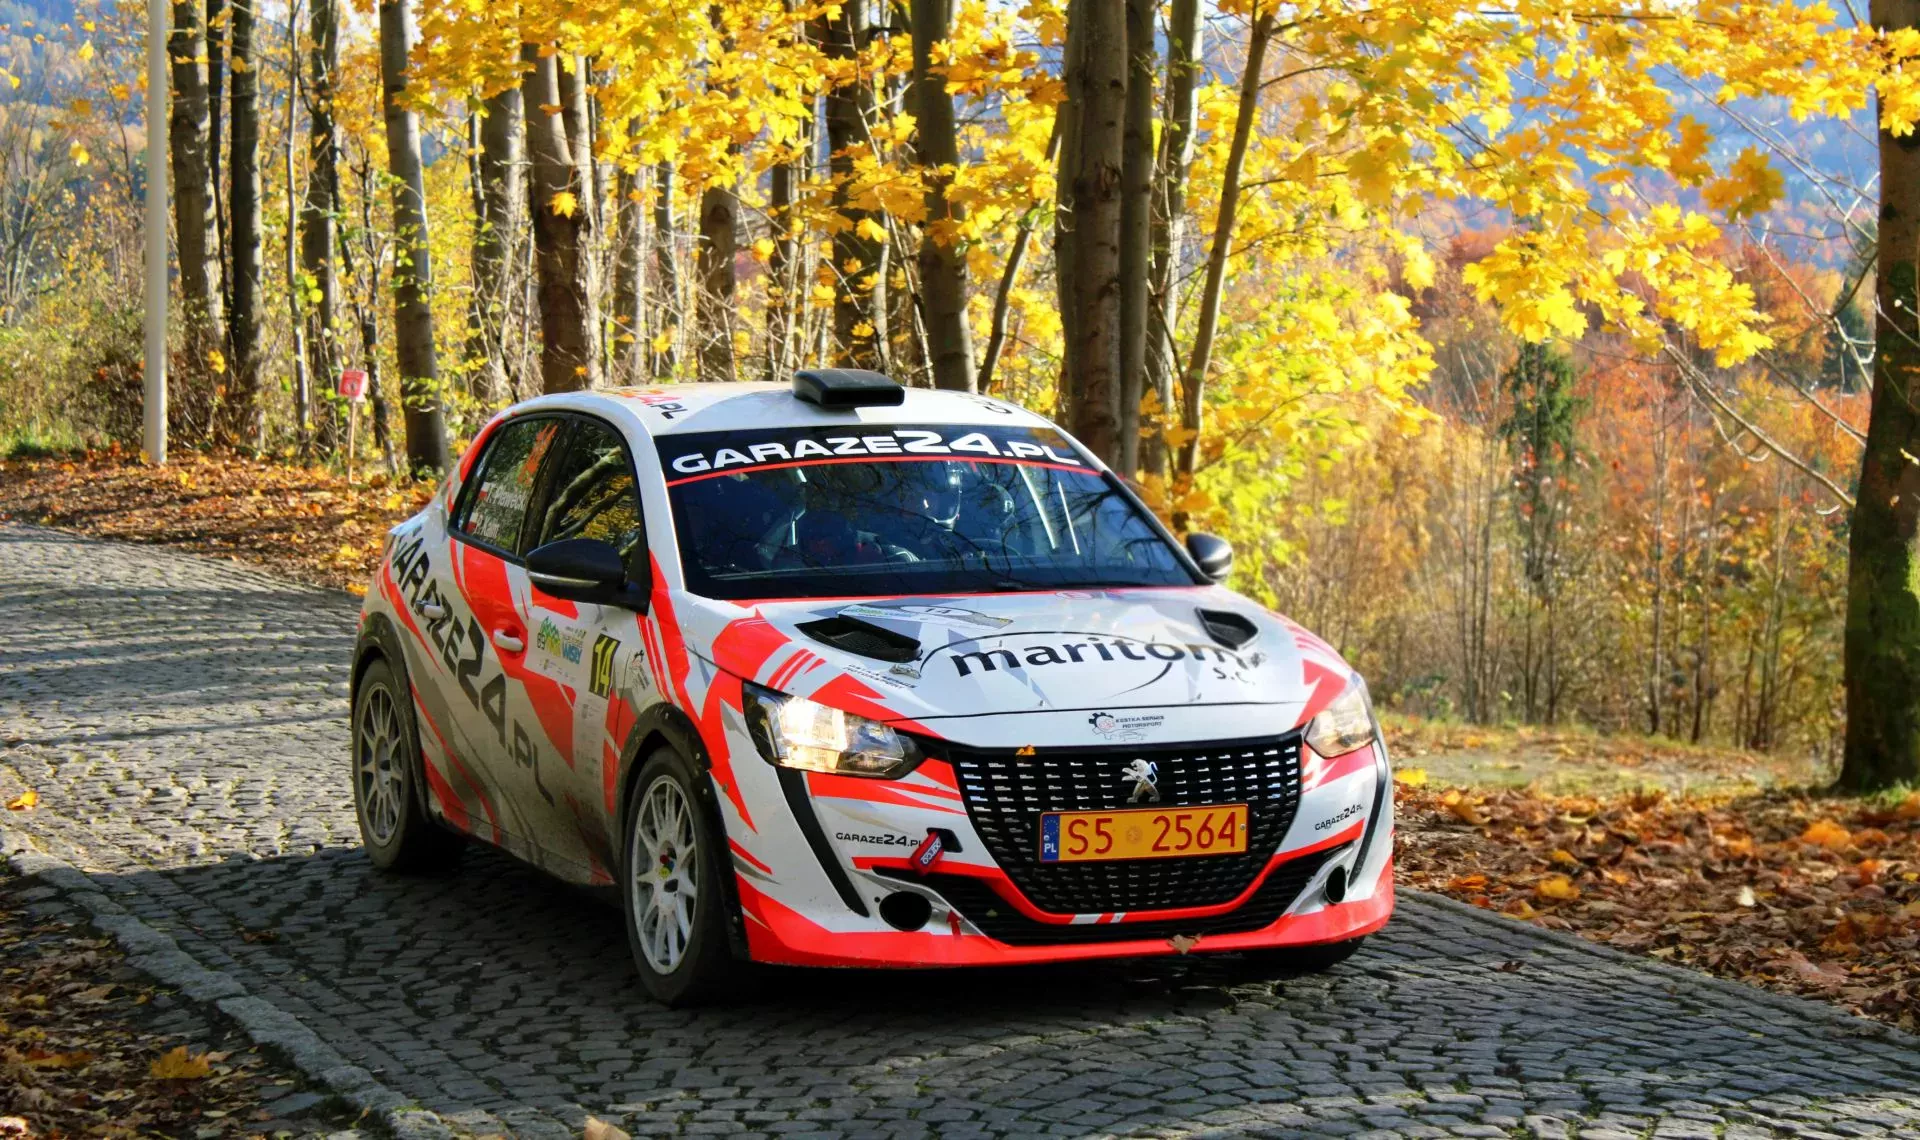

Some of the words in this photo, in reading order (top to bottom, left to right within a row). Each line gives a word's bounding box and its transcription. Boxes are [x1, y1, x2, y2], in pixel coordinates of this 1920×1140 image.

[672, 431, 1081, 473] GARAZE24.PL
[594, 637, 618, 697] 14
[951, 636, 1249, 677] maritom
[1043, 843, 1057, 853] PL
[1067, 818, 1113, 855] S5
[1152, 811, 1236, 852] 2564
